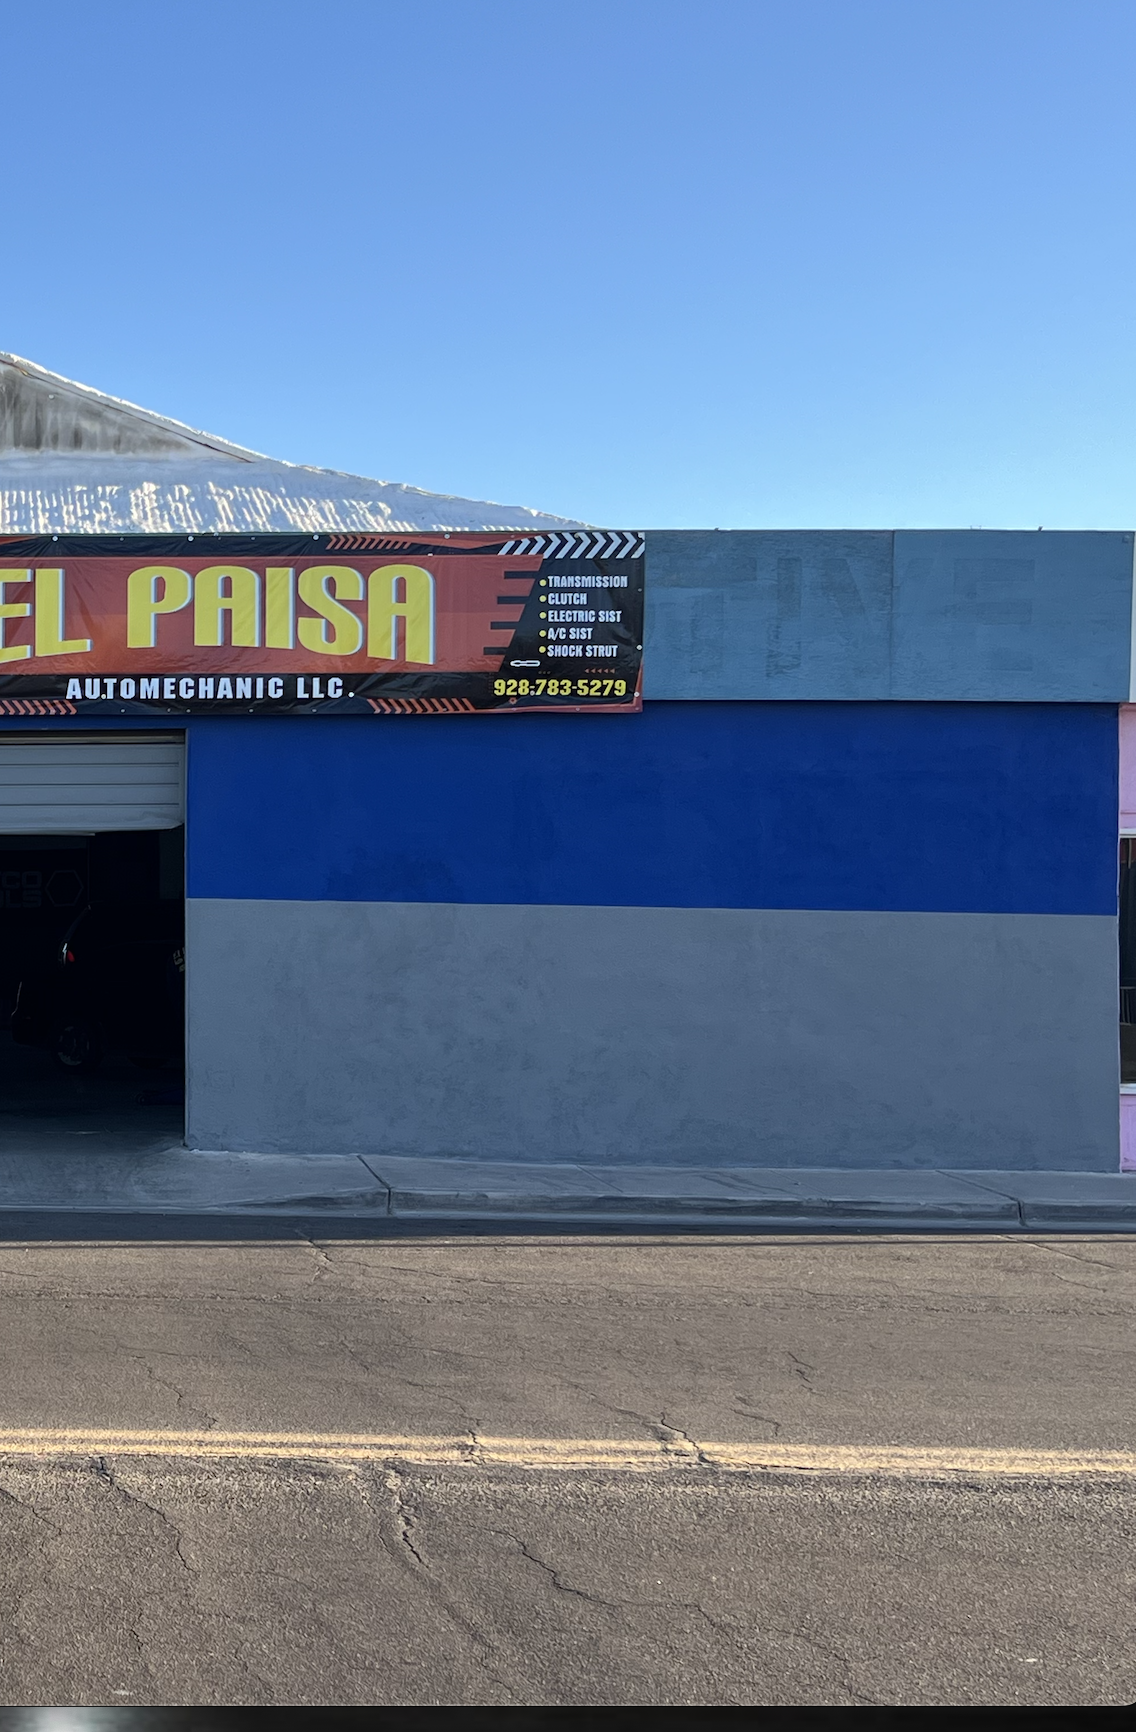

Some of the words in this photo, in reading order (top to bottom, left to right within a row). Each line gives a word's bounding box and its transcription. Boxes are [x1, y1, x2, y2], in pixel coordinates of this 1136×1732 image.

[548, 575, 628, 588] TRANSMISSION
[548, 593, 587, 605] CLUTCH
[126, 564, 437, 665] PAISA
[548, 610, 596, 622] ELECTRIC
[598, 610, 622, 622] SIST
[547, 628, 567, 640] A/C
[569, 628, 593, 640] SIST
[547, 645, 583, 658] SHOCK
[585, 645, 618, 658] STRUT
[65, 677, 284, 699] AUTOMECHANIC
[296, 677, 344, 699] LLC
[493, 679, 627, 697] 928-783-5279
